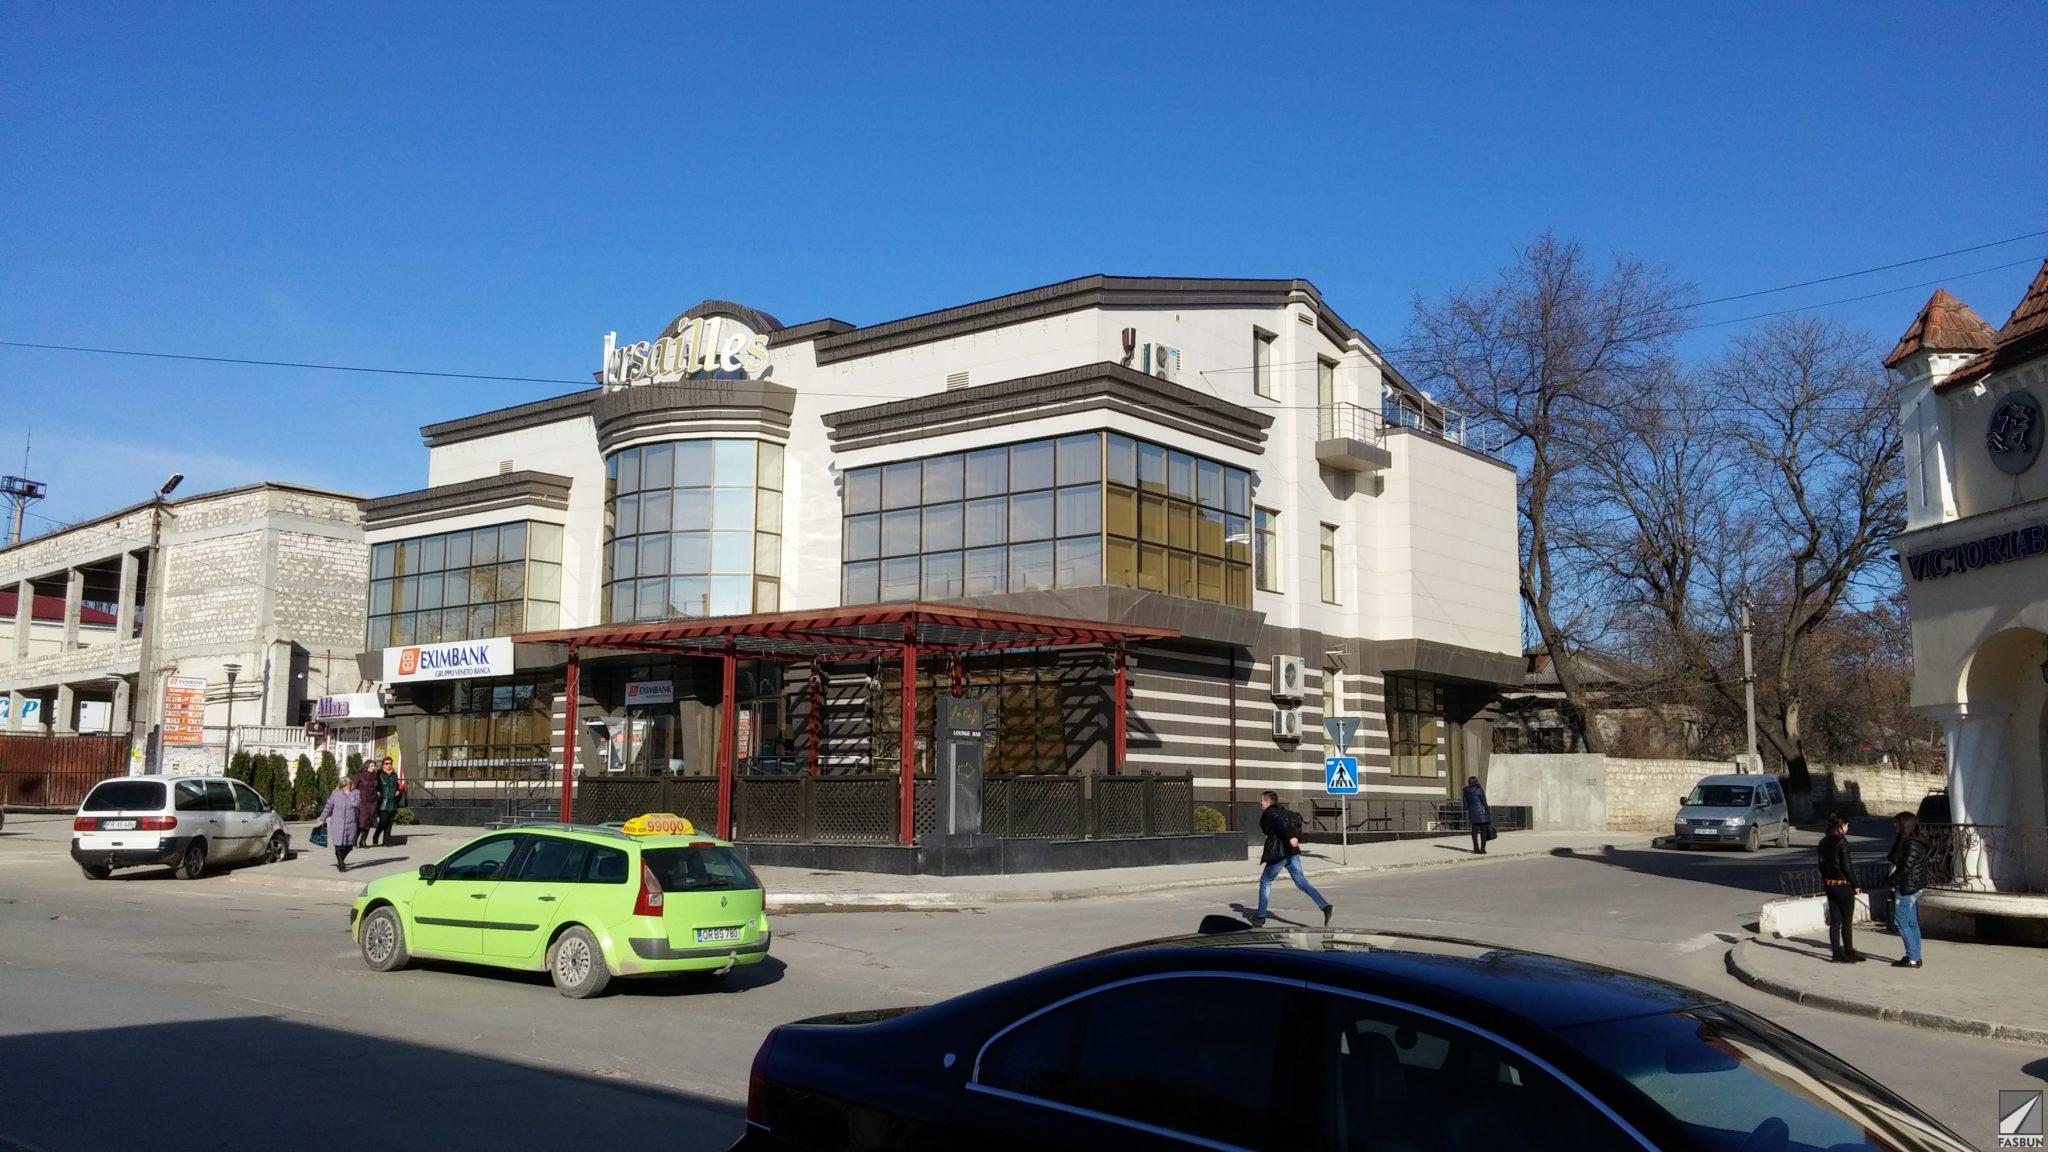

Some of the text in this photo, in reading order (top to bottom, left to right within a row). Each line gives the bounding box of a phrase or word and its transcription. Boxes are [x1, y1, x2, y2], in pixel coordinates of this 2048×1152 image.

[604, 316, 769, 394] rsailles
[420, 645, 490, 669] EXIMBANK
[435, 667, 491, 678] GRUPPO VENETO BANCA
[640, 686, 672, 695] EXIMBANK
[647, 821, 684, 832] 99000
